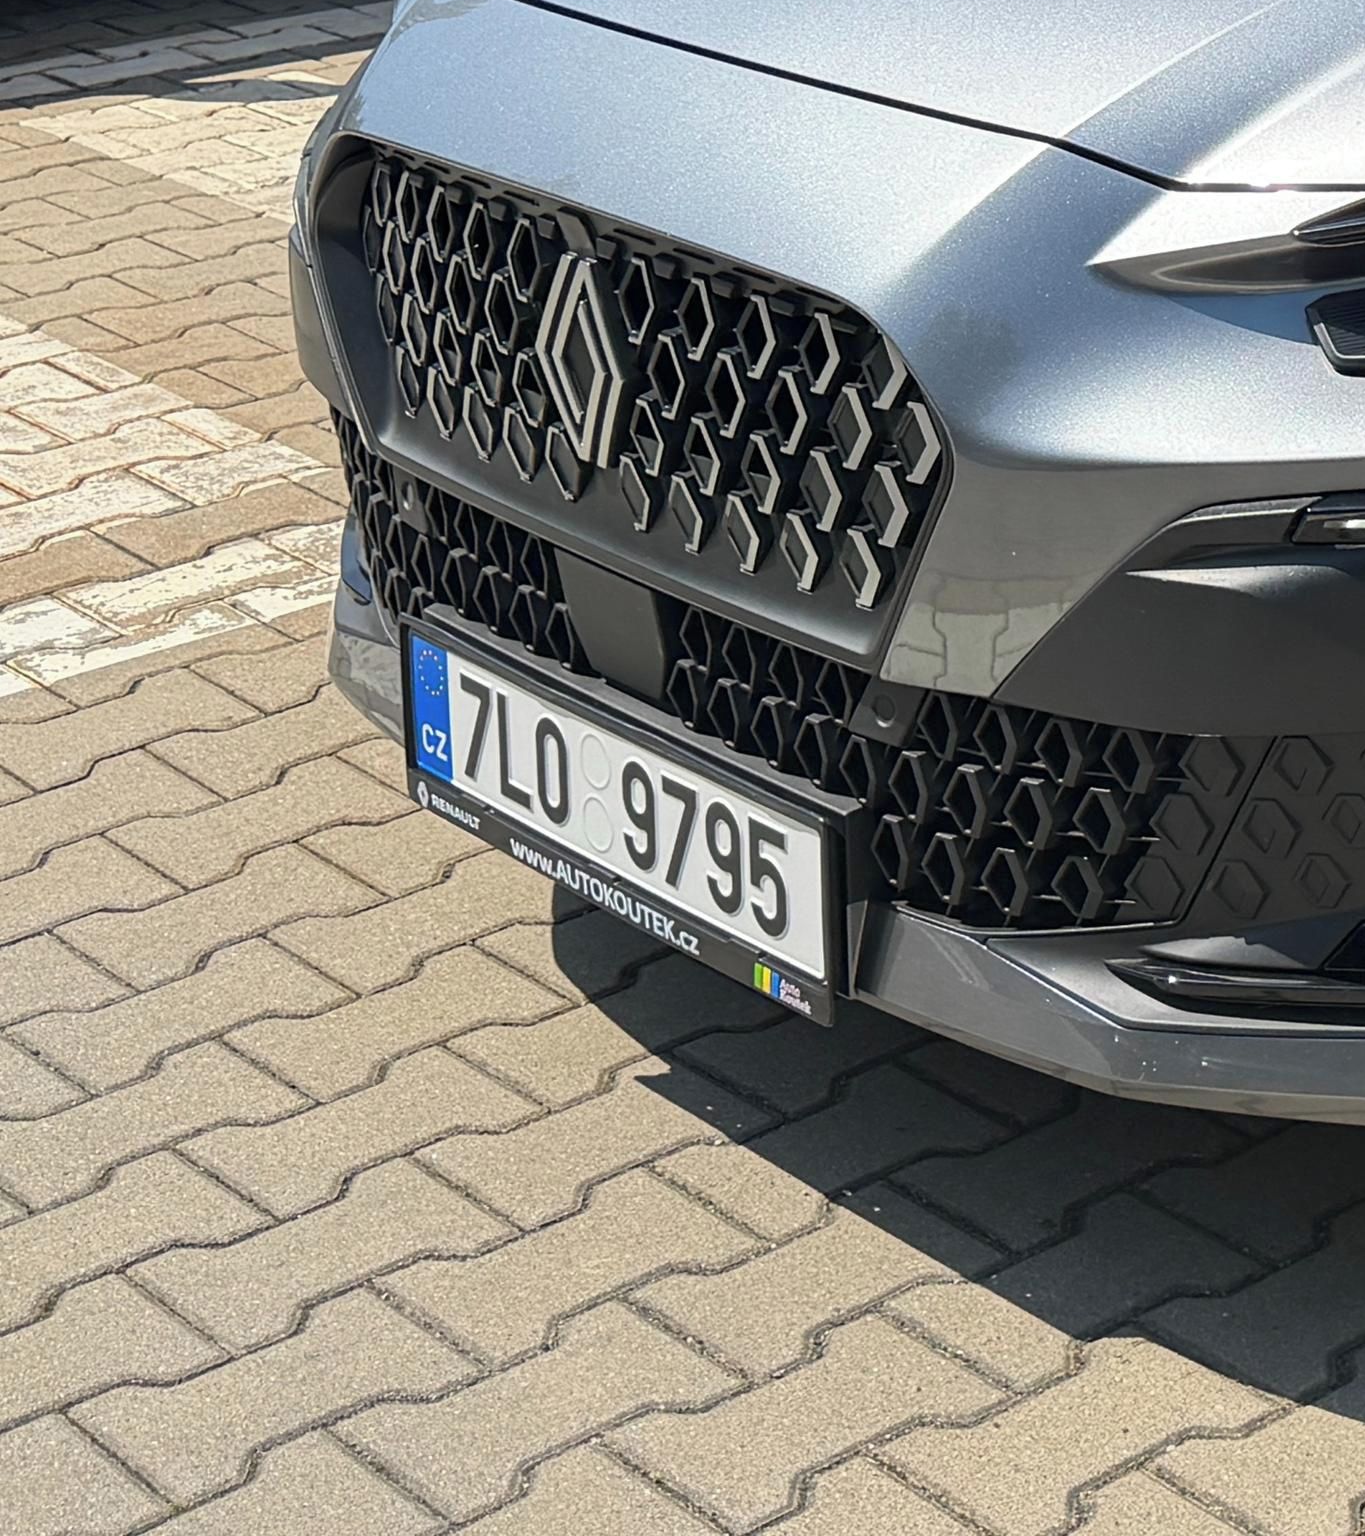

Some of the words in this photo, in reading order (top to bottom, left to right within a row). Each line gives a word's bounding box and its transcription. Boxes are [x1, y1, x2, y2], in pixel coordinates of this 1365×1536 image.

[421, 723, 449, 762] CZ
[430, 793, 481, 831] RENAULT
[621, 760, 790, 940] 9795
[509, 837, 701, 956] www.AUTOKOUTEK.cz
